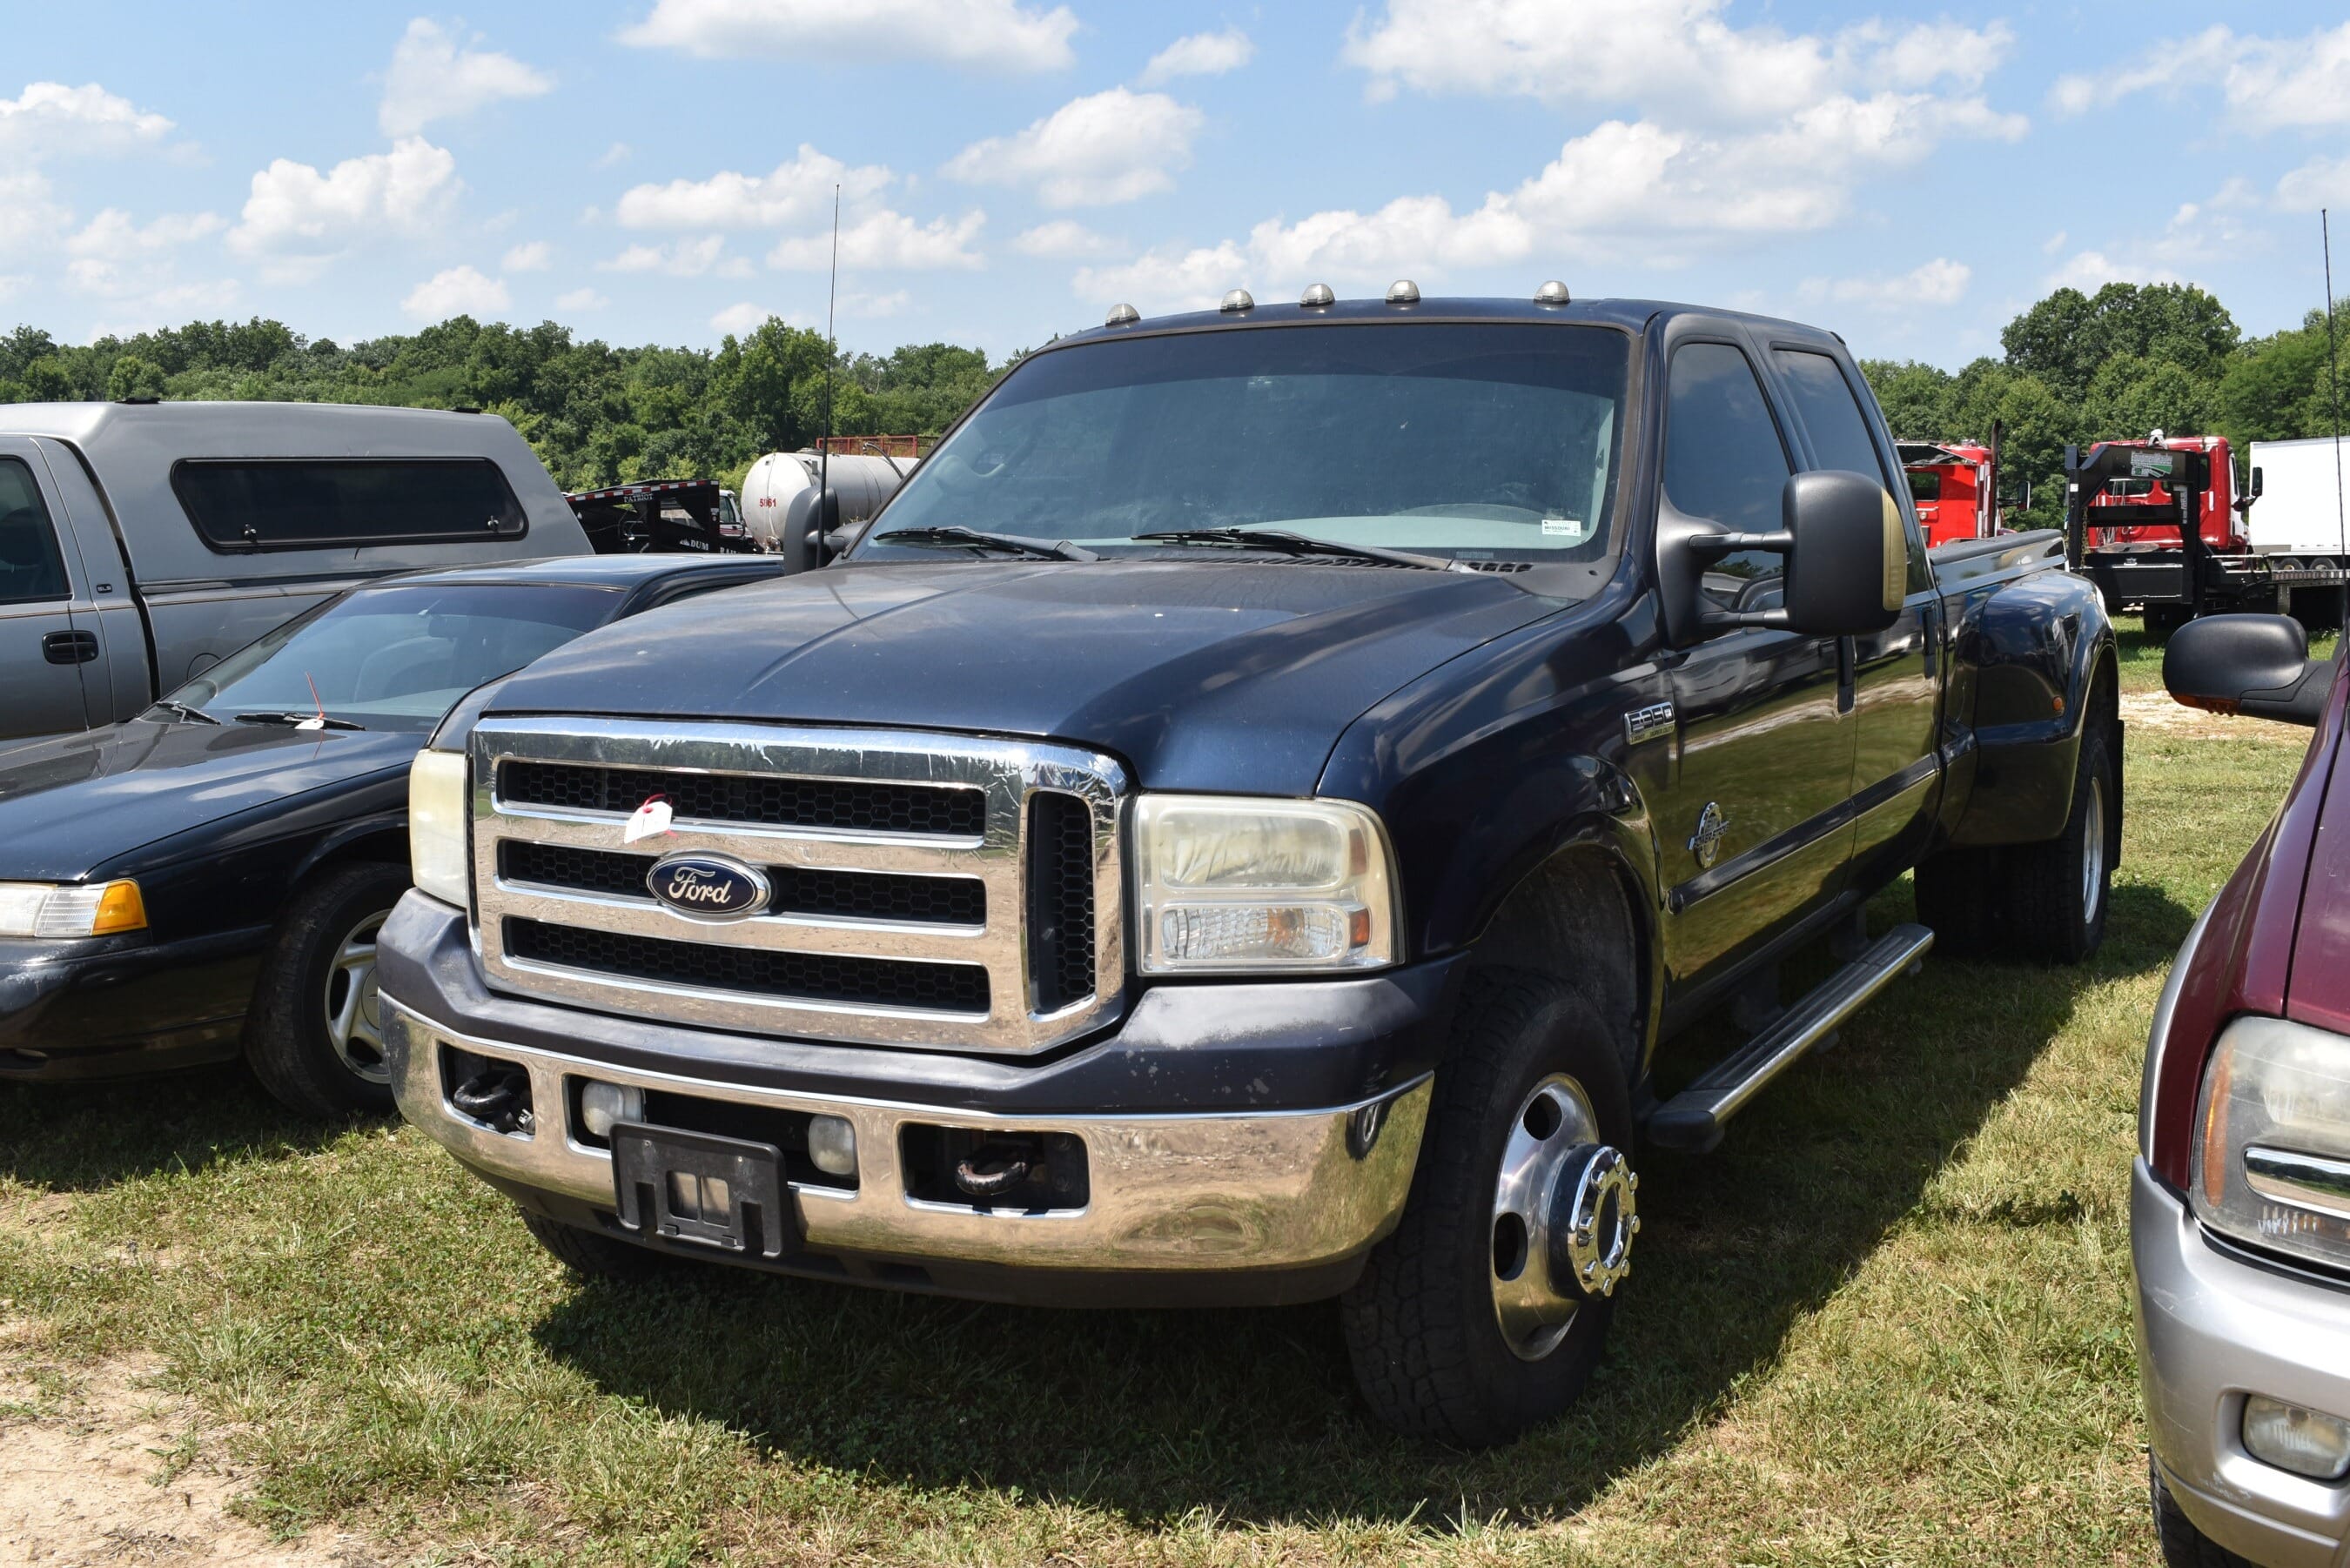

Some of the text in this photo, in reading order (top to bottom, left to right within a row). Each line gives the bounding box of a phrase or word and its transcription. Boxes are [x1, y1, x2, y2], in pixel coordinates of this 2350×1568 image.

[623, 493, 654, 503] PATRIOT
[690, 539, 709, 551] DUM
[668, 866, 732, 904] Ford
